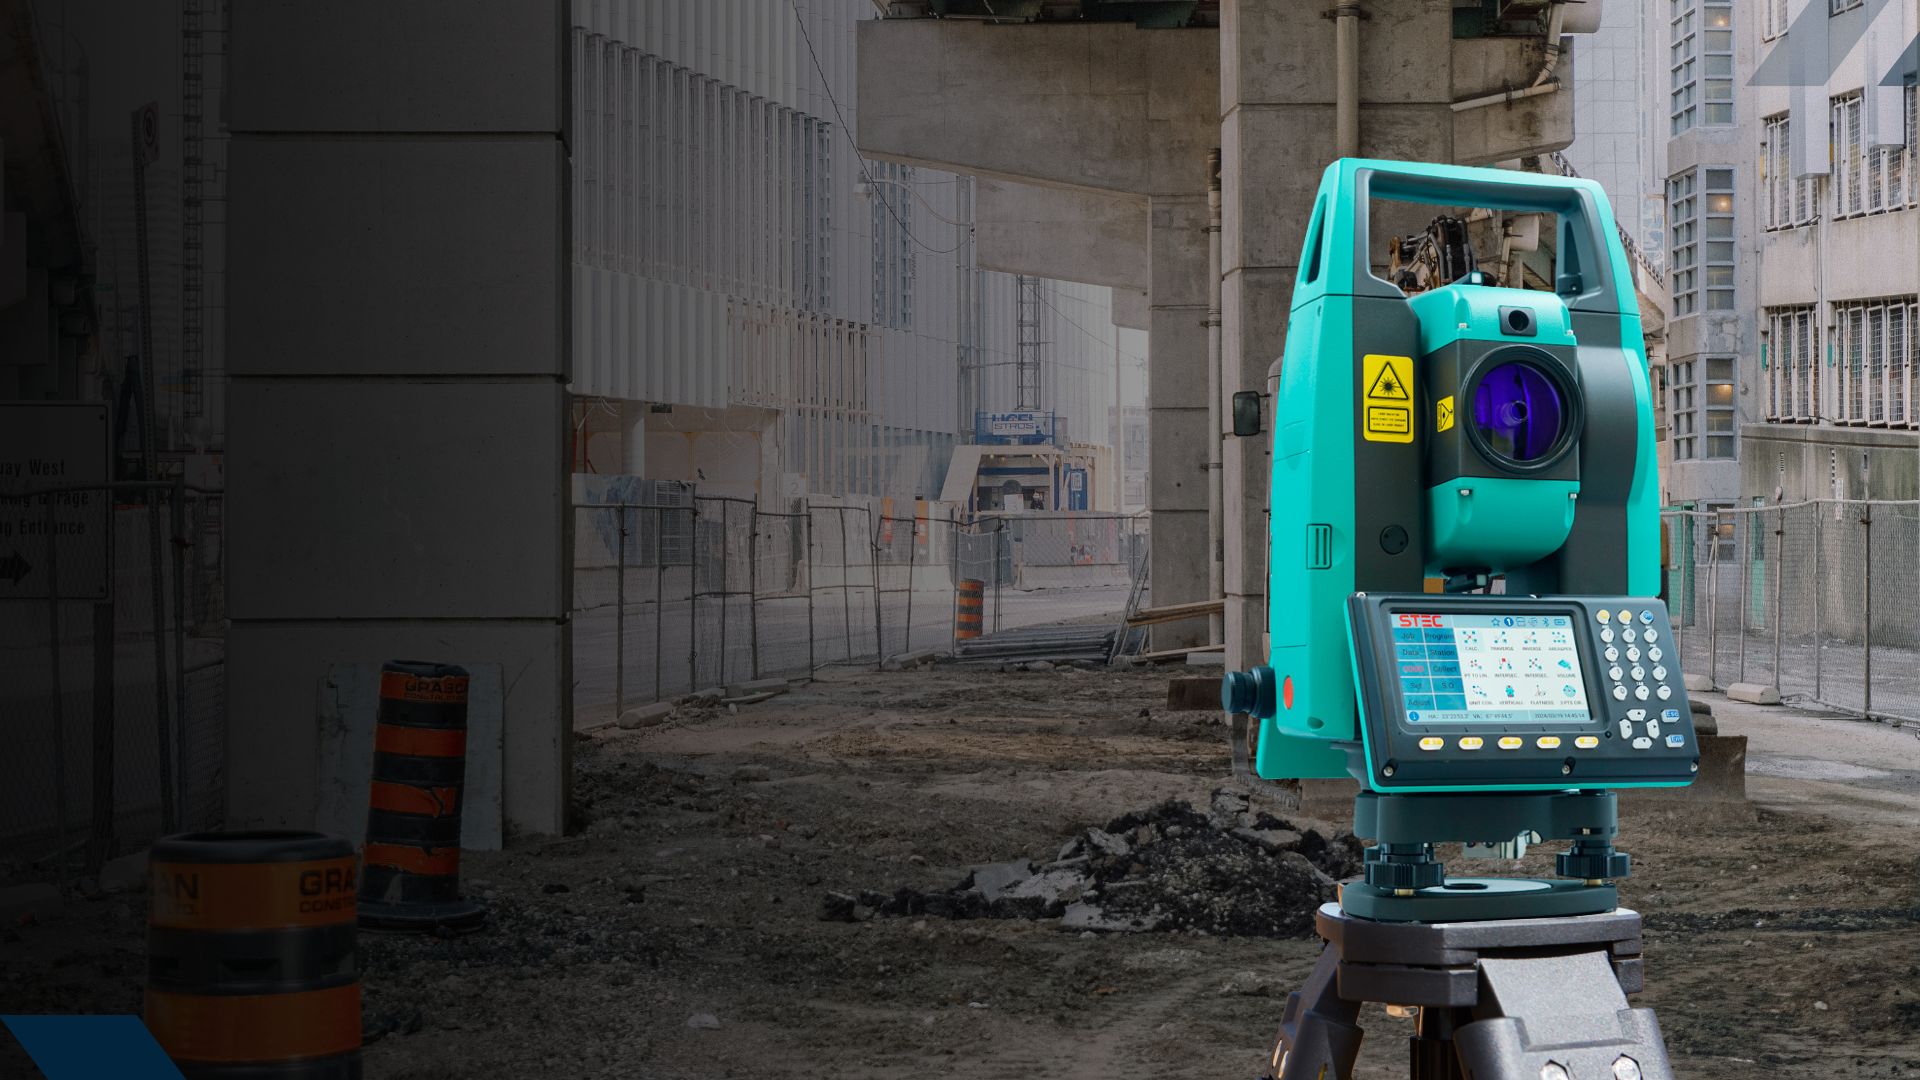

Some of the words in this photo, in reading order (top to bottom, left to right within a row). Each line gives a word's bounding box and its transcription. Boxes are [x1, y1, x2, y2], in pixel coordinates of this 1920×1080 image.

[994, 422, 1034, 430] STROS
[30, 459, 65, 476] West
[38, 490, 89, 508] Grage
[1399, 614, 1443, 627] STEC
